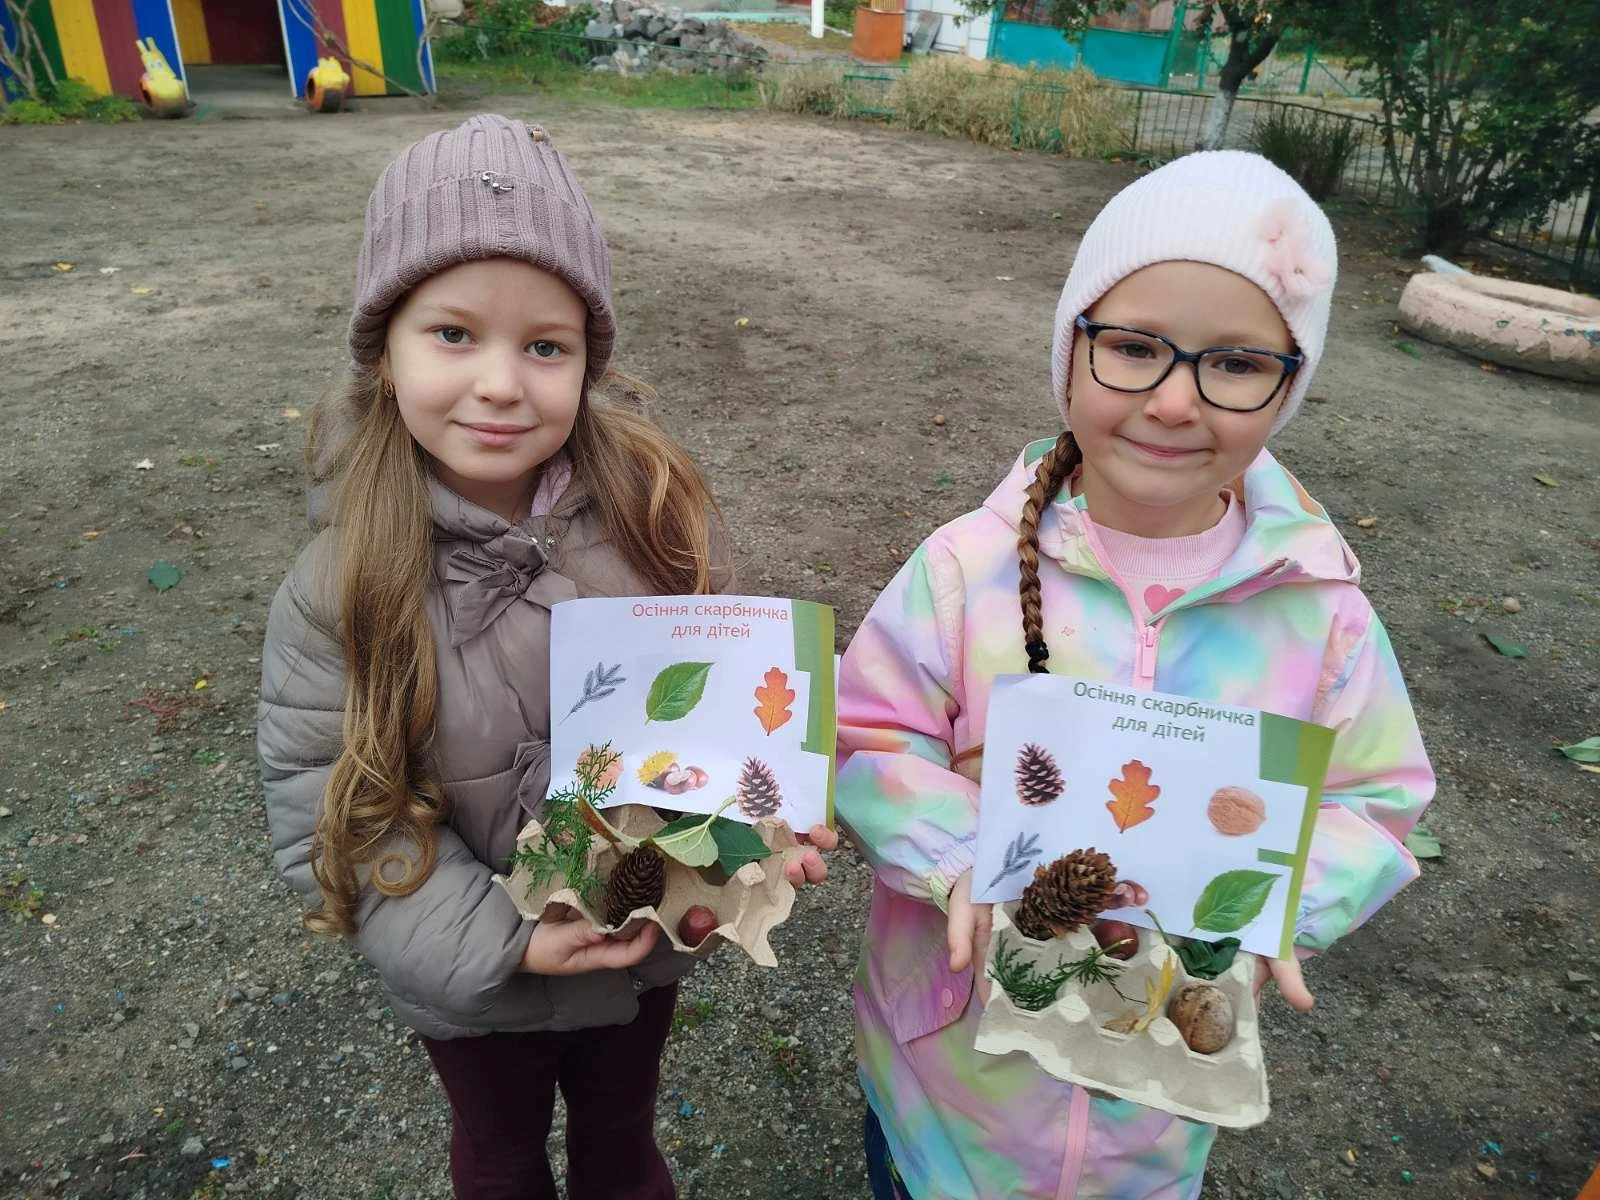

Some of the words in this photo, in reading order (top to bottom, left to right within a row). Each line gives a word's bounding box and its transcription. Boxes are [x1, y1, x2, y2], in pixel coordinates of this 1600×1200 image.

[632, 603, 688, 617] Осіння
[694, 603, 788, 621] скарбничка
[671, 624, 701, 639] для
[706, 622, 750, 639] дітей
[1073, 681, 1136, 706] Осіння
[1142, 697, 1255, 727] скарбничка
[1112, 715, 1147, 733] для
[1152, 722, 1205, 743] дітей
